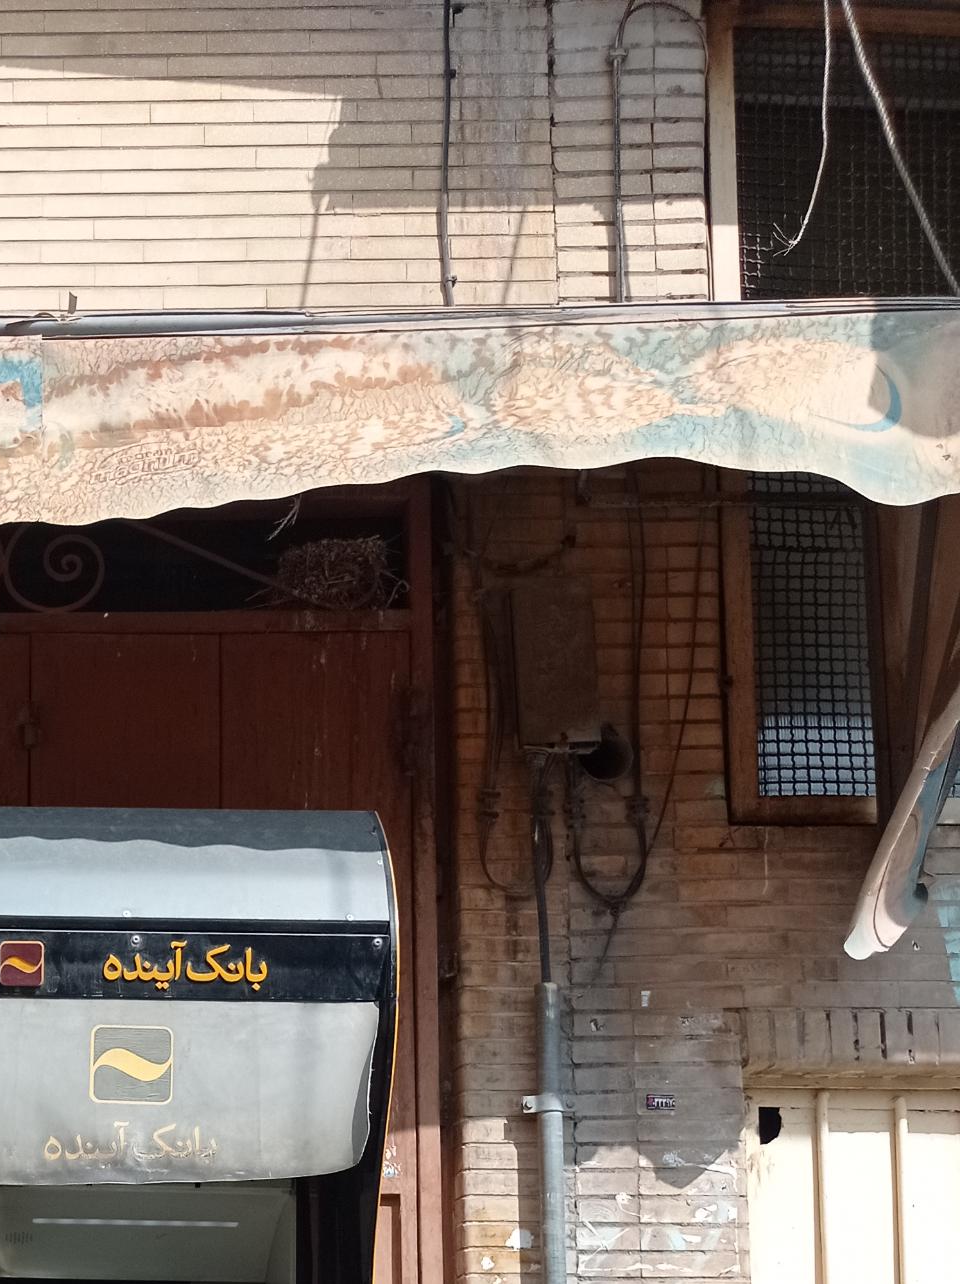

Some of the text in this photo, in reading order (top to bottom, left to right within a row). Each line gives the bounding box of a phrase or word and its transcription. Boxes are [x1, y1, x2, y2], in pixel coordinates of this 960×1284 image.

[103, 940, 268, 991] بانک آینده
[44, 1121, 218, 1168] بانک آینده
